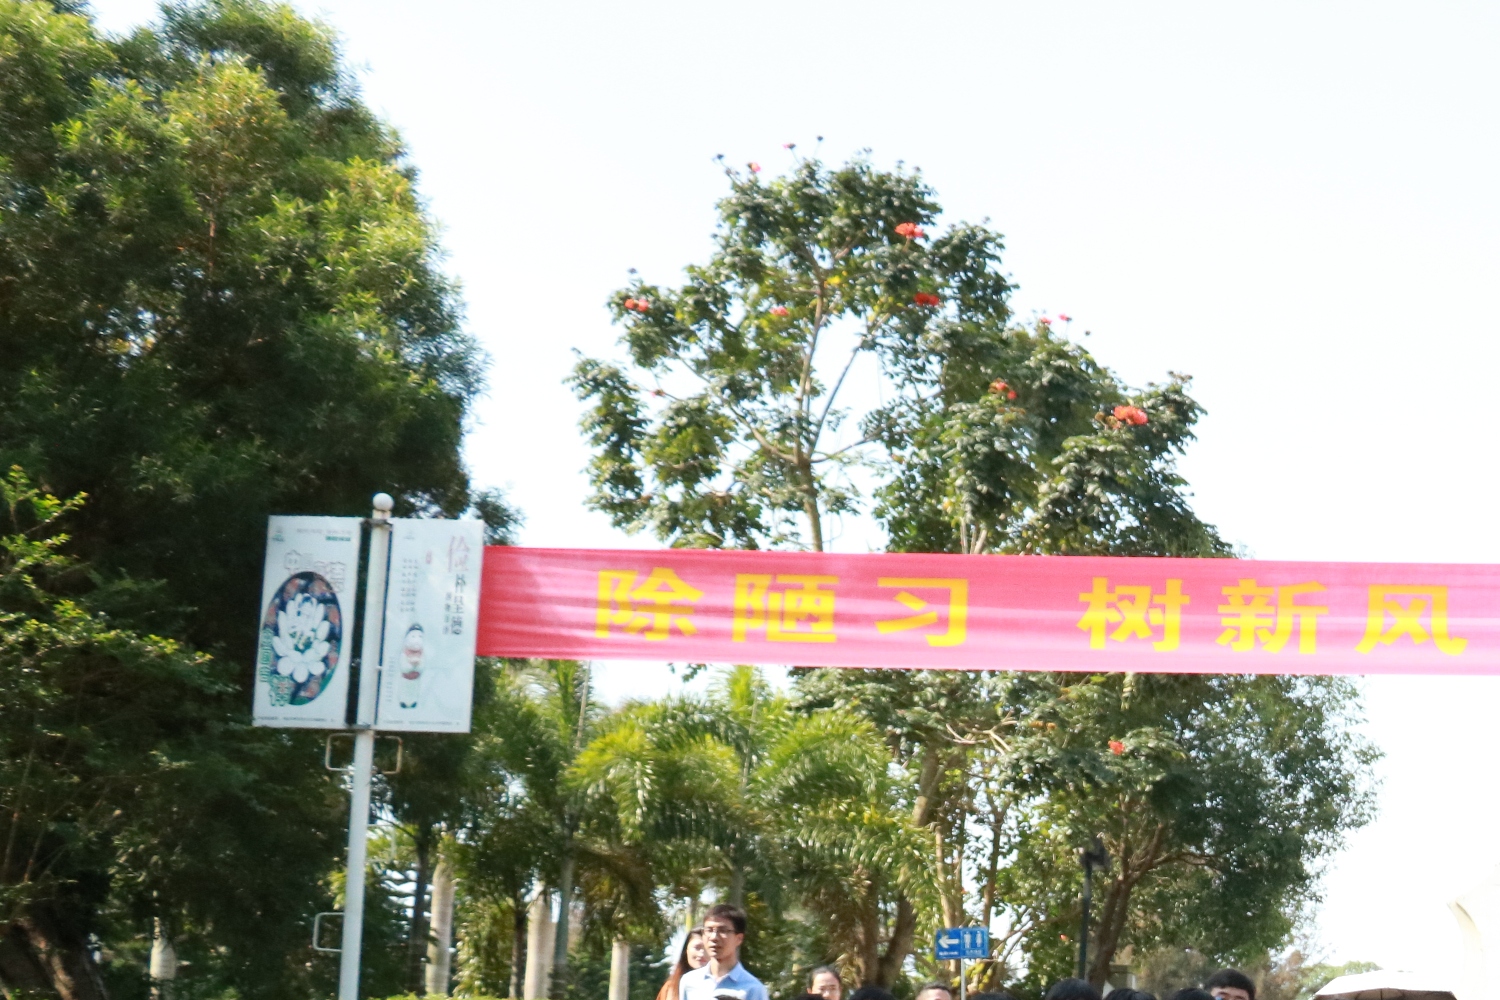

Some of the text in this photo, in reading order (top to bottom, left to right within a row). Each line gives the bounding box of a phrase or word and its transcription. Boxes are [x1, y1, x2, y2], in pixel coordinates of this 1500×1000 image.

[594, 567, 970, 648] 除陋习
[1077, 577, 1468, 656] 树新风
